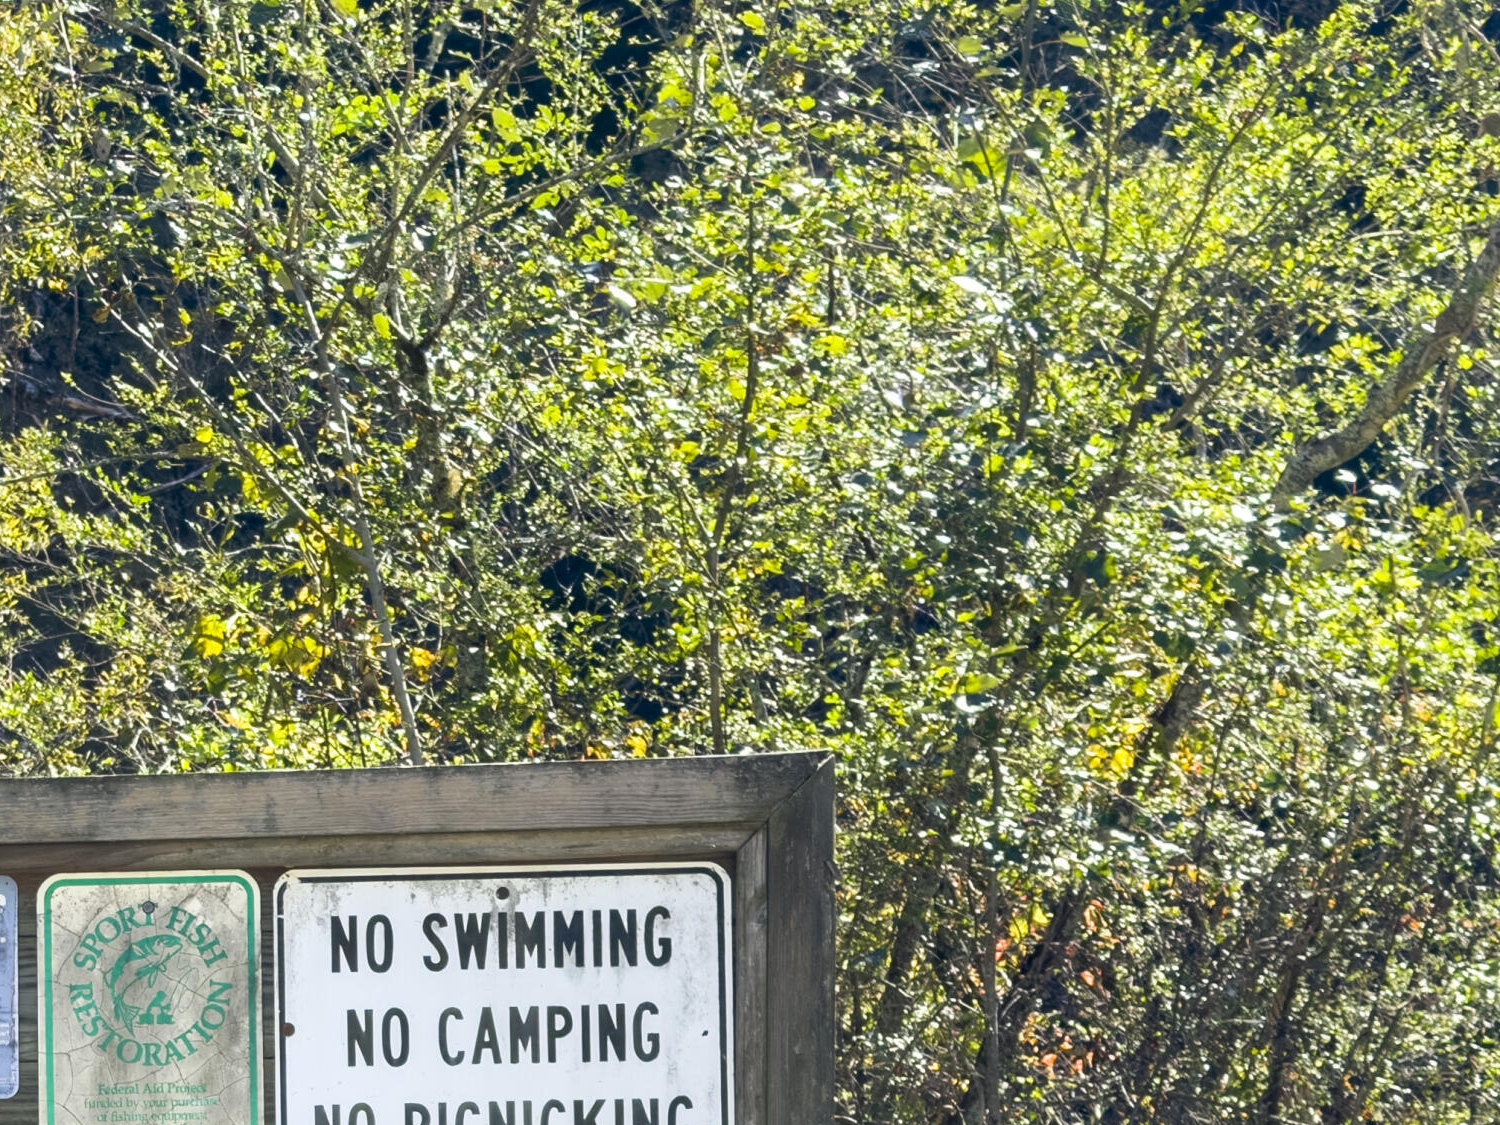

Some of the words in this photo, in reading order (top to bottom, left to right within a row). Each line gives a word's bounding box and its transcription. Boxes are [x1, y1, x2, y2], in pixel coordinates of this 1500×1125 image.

[73, 902, 158, 972] SPORT
[165, 906, 228, 968] FISH
[330, 914, 394, 973] NO
[422, 905, 672, 972] SWIMMING
[69, 979, 233, 1067] RESTORATION
[346, 1007, 410, 1067] NO
[438, 1001, 661, 1066] CAMPING
[84, 1097, 122, 1109] funded
[126, 1098, 138, 1108] by
[143, 1099, 167, 1108] your
[171, 1097, 218, 1110] purchase
[97, 1111, 107, 1122] of
[111, 1111, 148, 1124] fishing
[151, 1111, 207, 1123] equipment
[98, 1084, 139, 1095] Federal
[143, 1084, 164, 1094] Aid
[167, 1083, 206, 1094] Project
